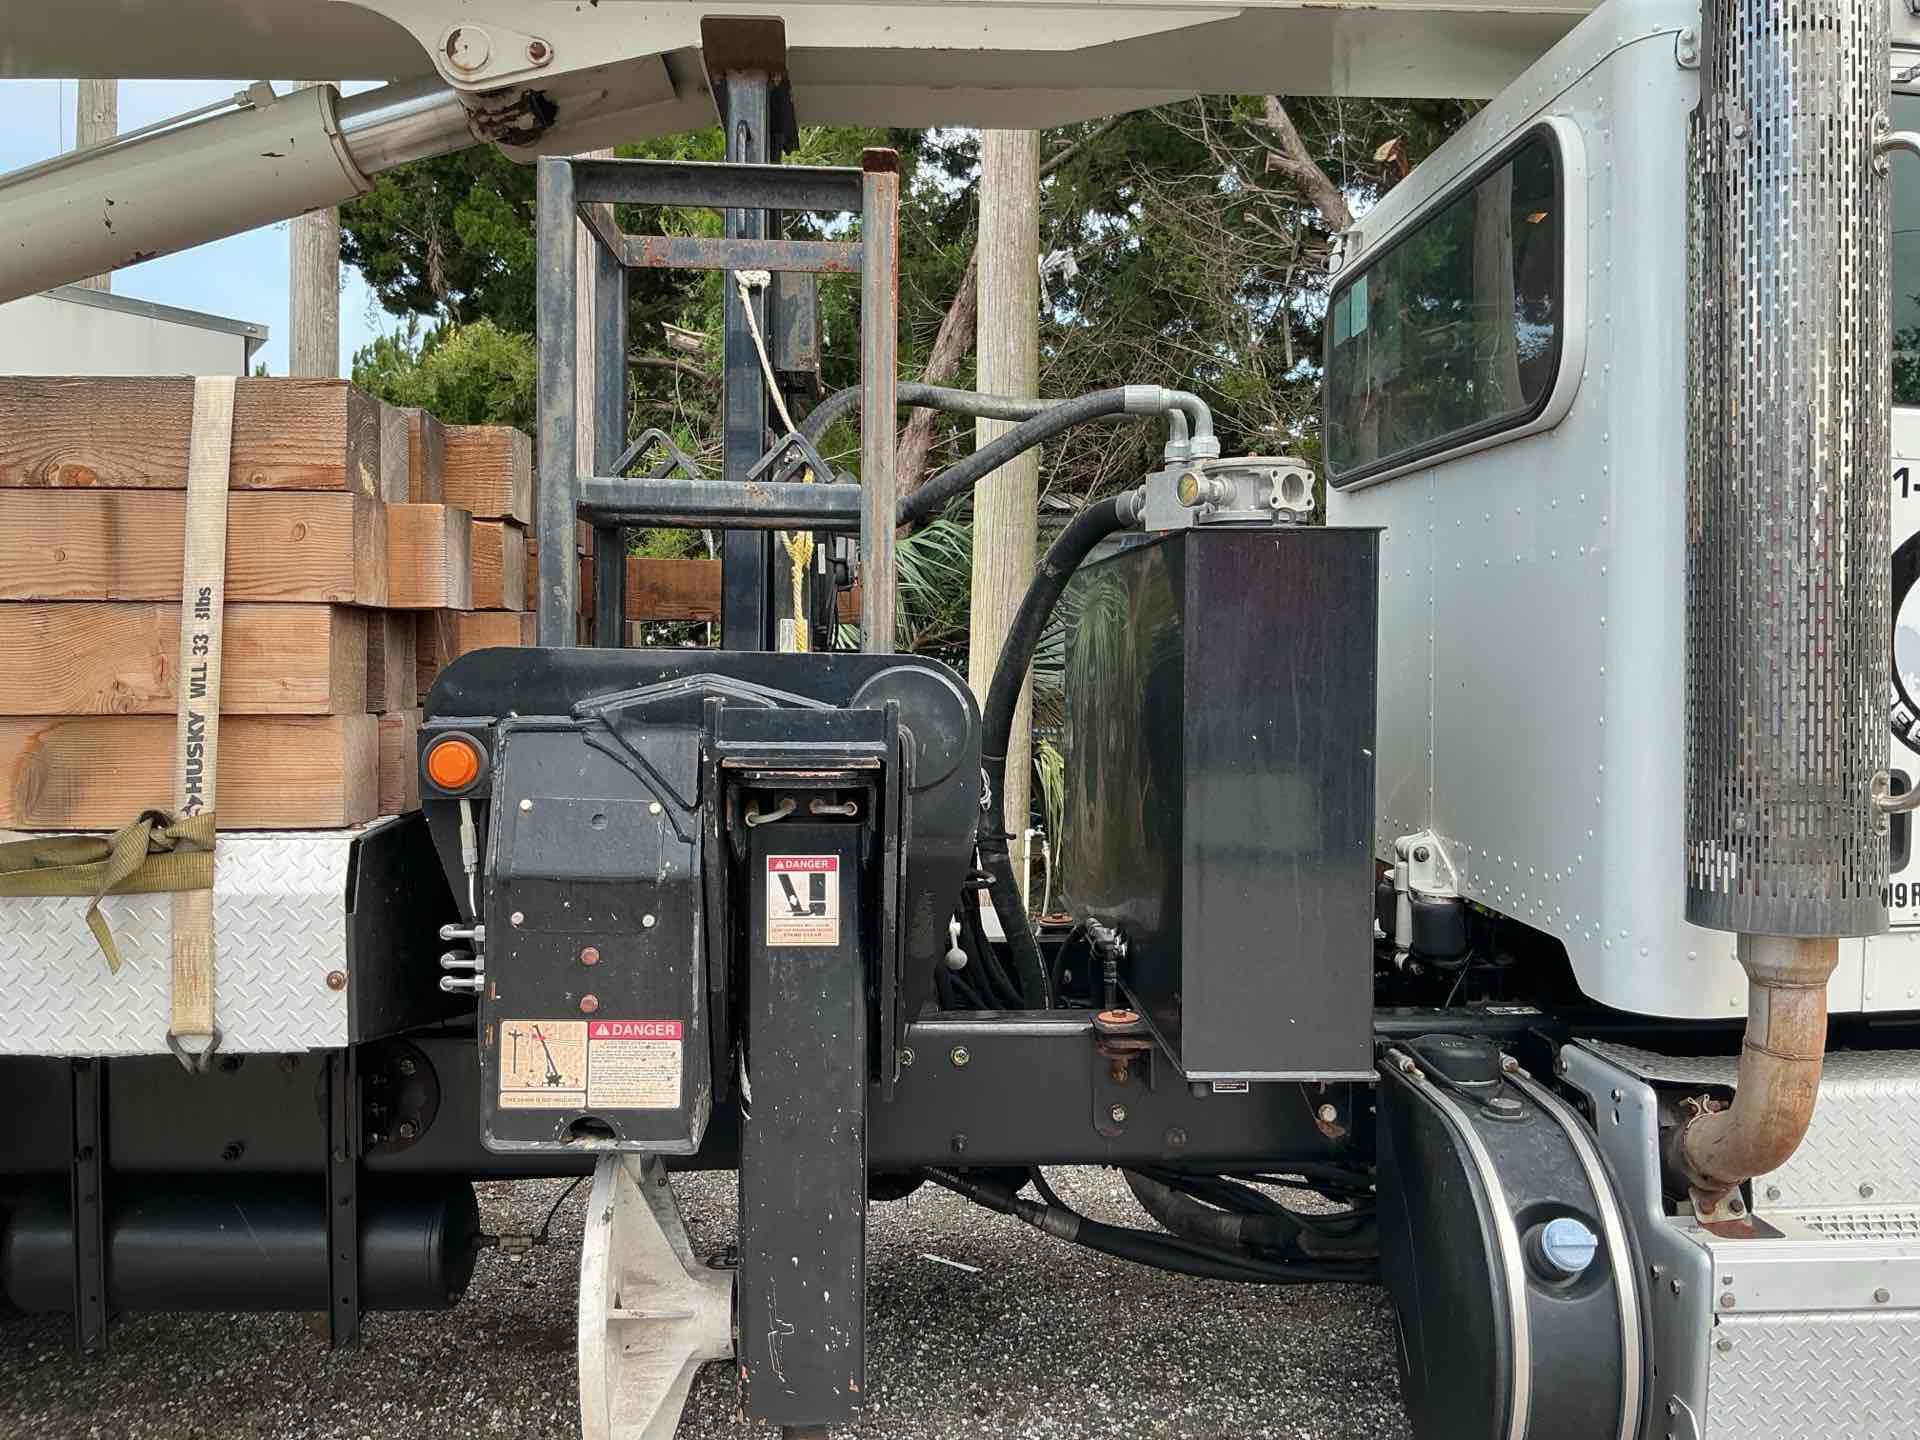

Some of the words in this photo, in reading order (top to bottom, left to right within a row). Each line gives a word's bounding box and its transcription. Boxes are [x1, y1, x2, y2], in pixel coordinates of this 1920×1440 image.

[190, 662, 208, 699] WLL
[185, 711, 205, 794] HUSKY
[785, 860, 828, 869] DANGER
[612, 1023, 676, 1036] DANGER
